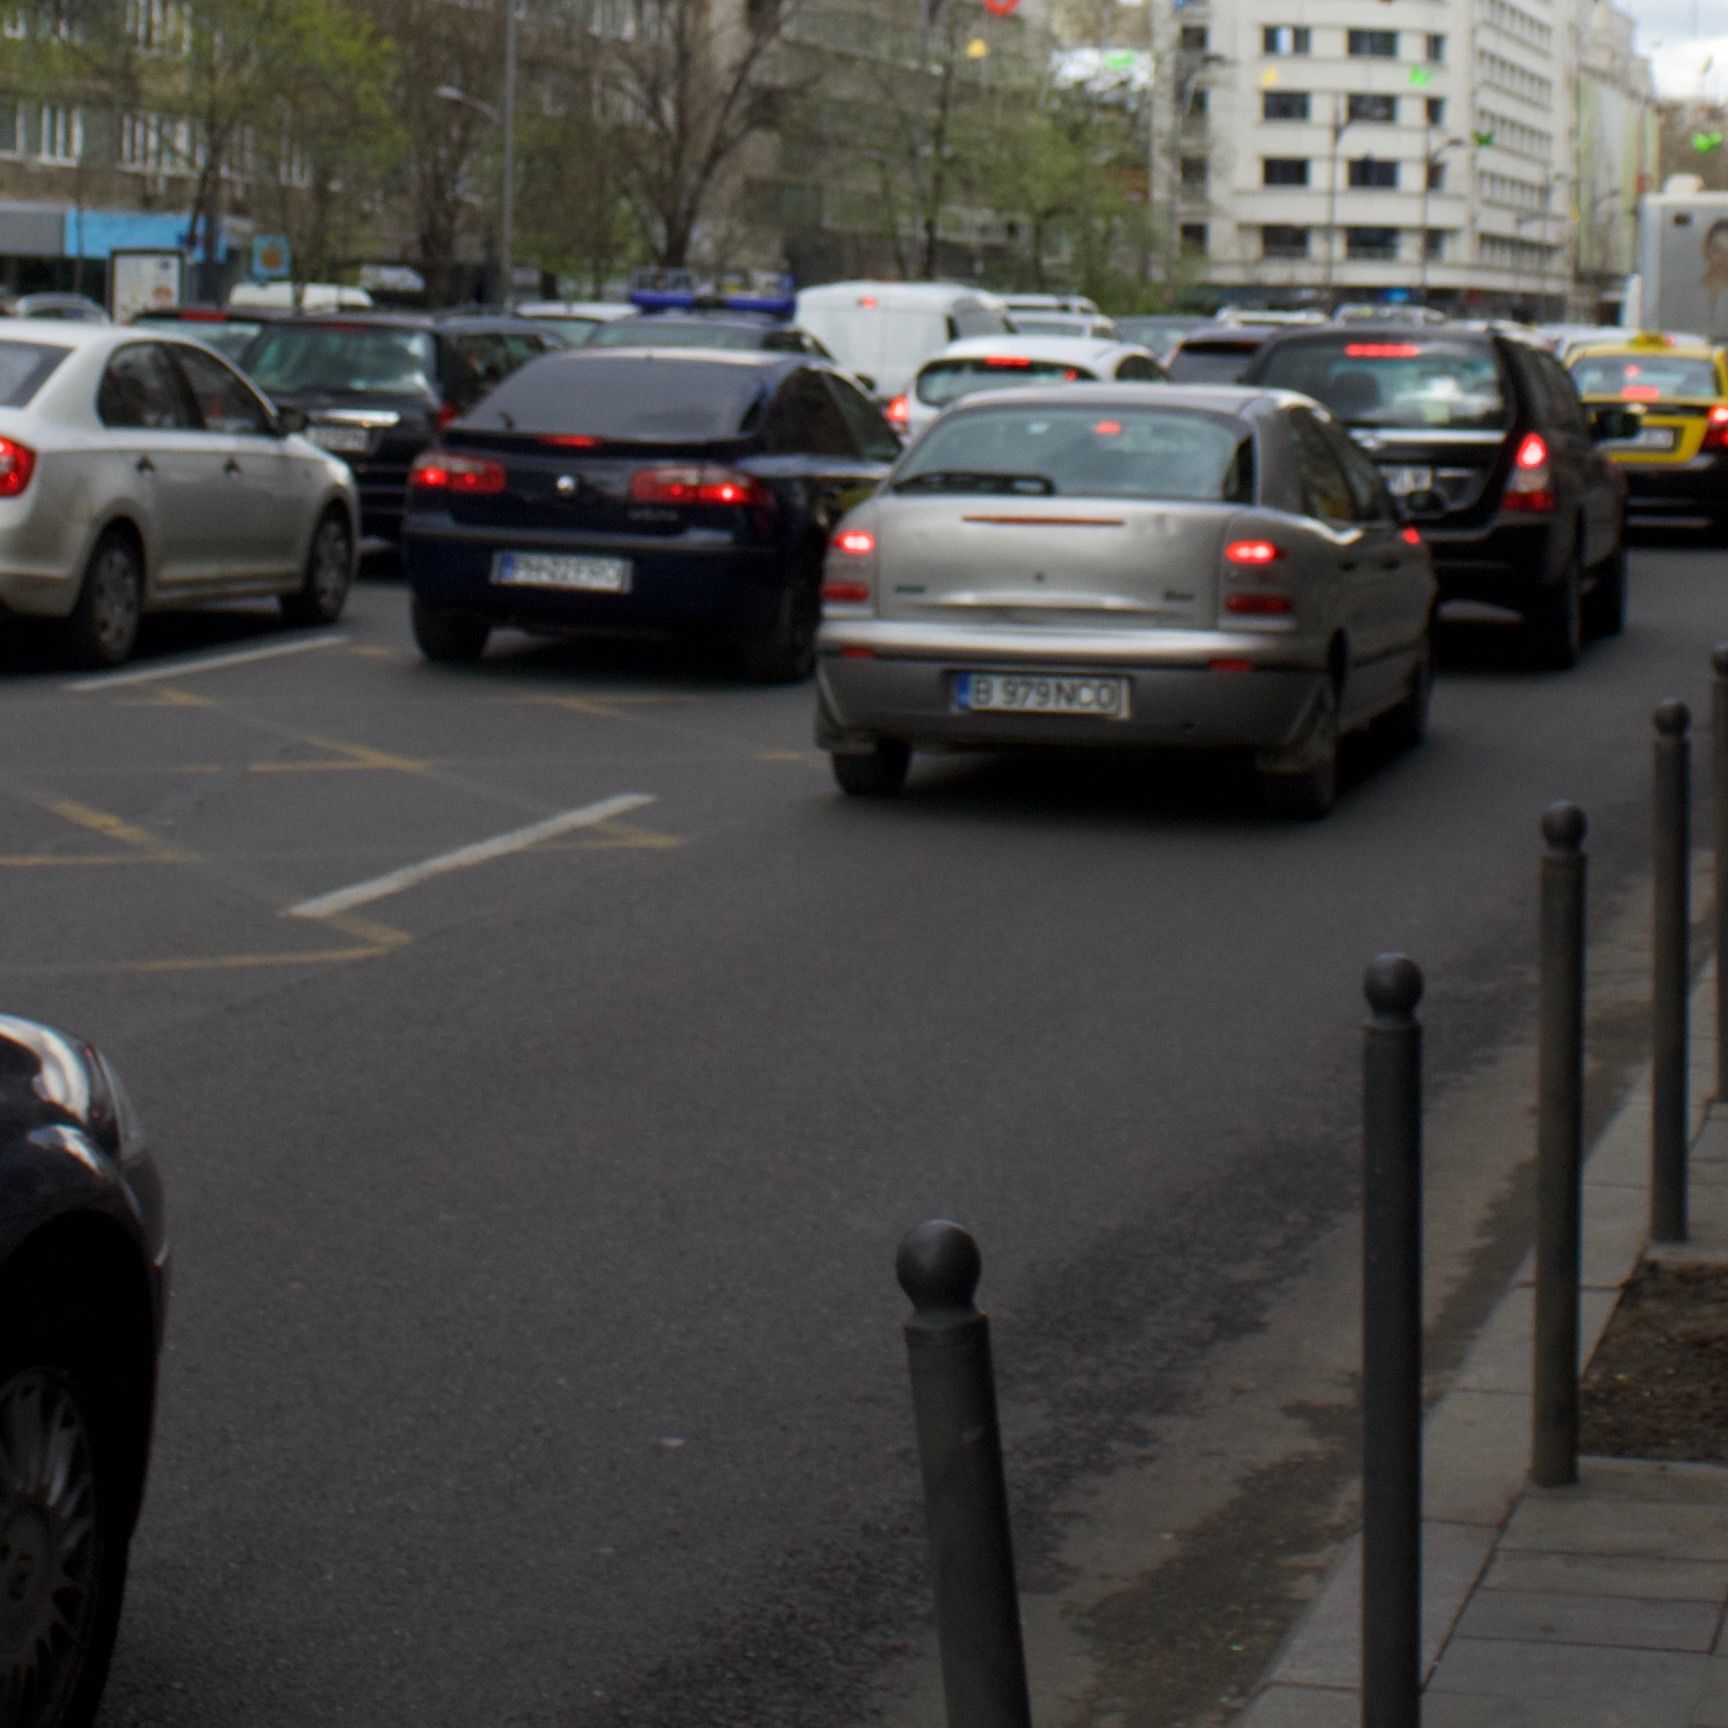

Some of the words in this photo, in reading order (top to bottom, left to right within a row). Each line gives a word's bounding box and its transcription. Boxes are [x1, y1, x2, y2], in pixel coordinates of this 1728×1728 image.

[973, 678, 992, 707] B
[1002, 679, 1053, 708] 979
[1054, 680, 1116, 709] NCO
